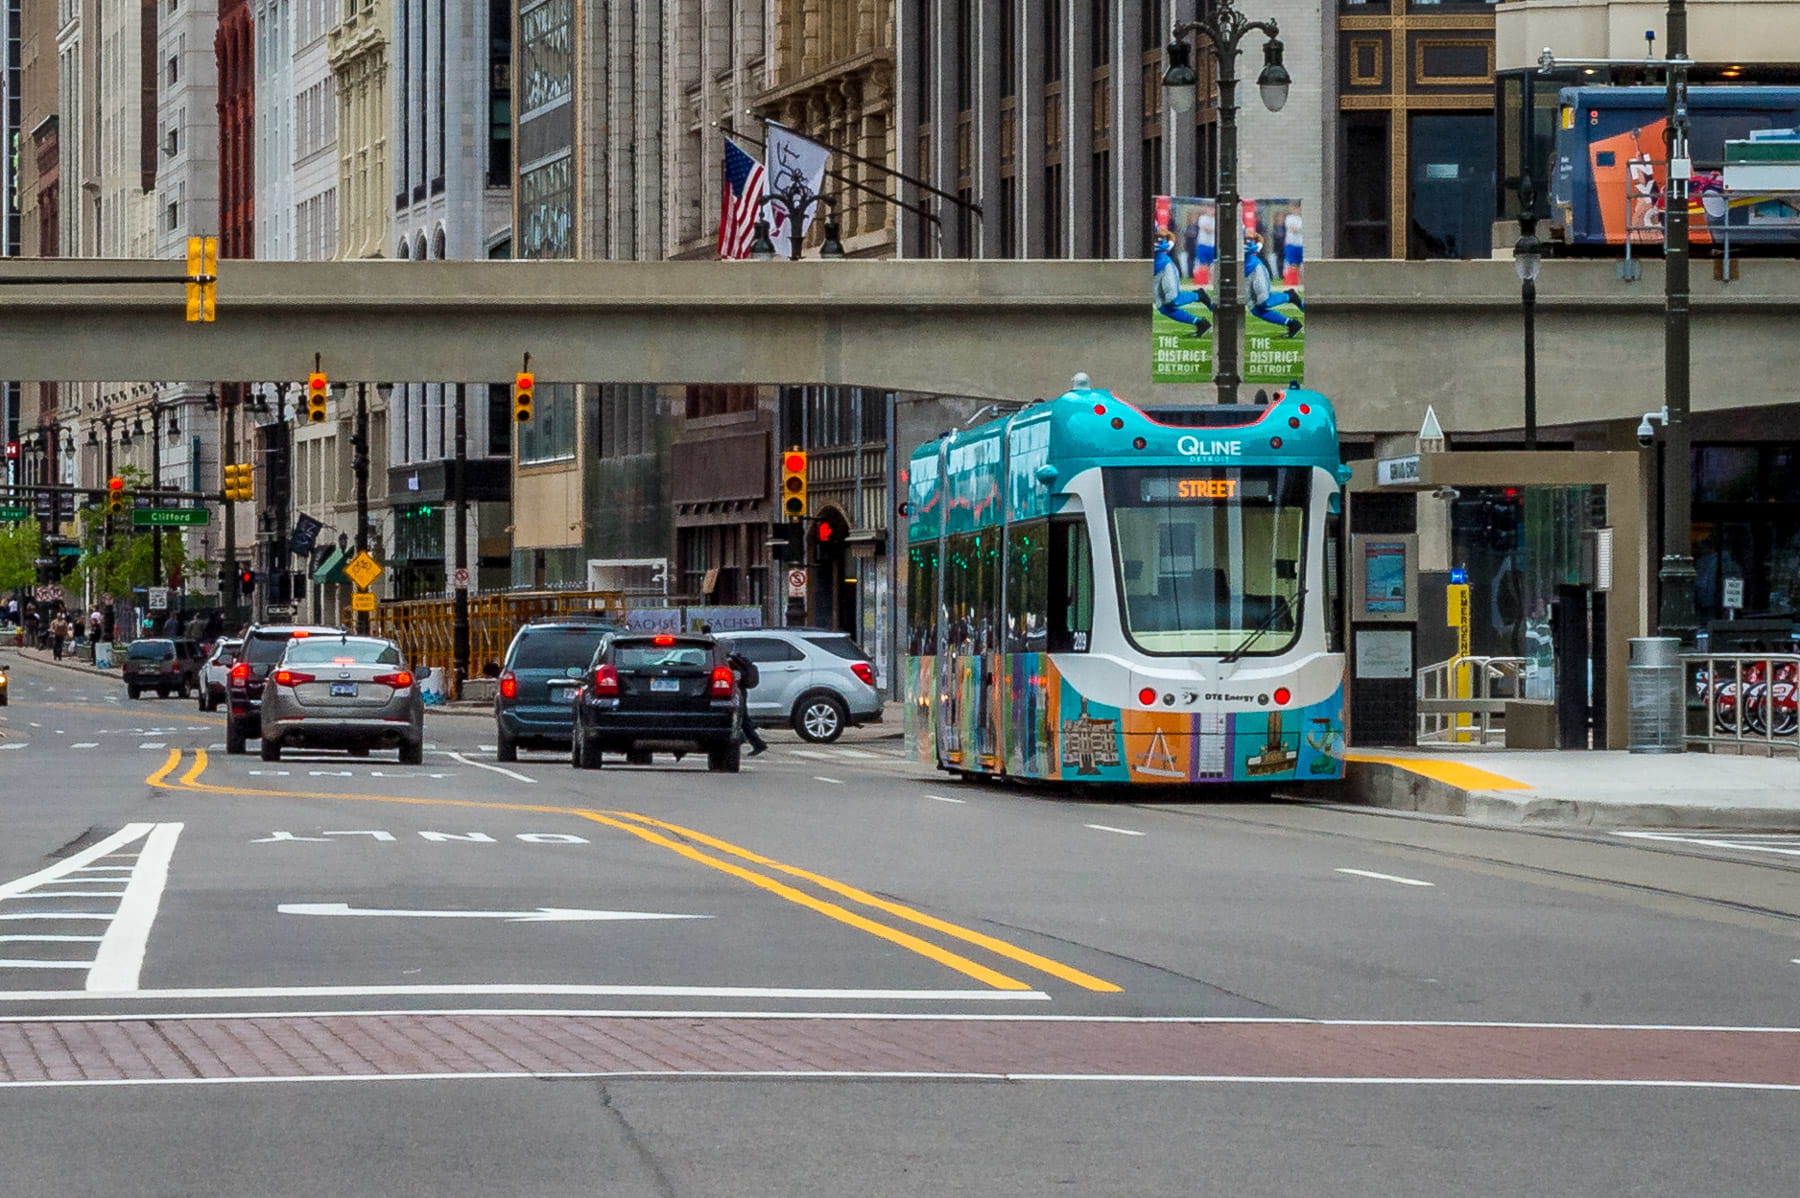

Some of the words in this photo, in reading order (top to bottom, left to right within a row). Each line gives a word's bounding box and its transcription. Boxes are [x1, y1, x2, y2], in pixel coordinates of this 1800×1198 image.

[1158, 336, 1179, 348] THE
[1251, 337, 1270, 349] THE
[1157, 350, 1206, 362] DISTRICT
[1250, 350, 1299, 363] DISTRICT
[1157, 364, 1200, 373] DETROIT
[1250, 364, 1293, 373] DETROIT
[1177, 435, 1242, 456] QLINE
[1178, 479, 1237, 498] STREET
[151, 512, 191, 521] Clifford
[1205, 693, 1222, 701] DTE
[1224, 694, 1255, 702] Energy
[250, 831, 591, 844] ONLY
